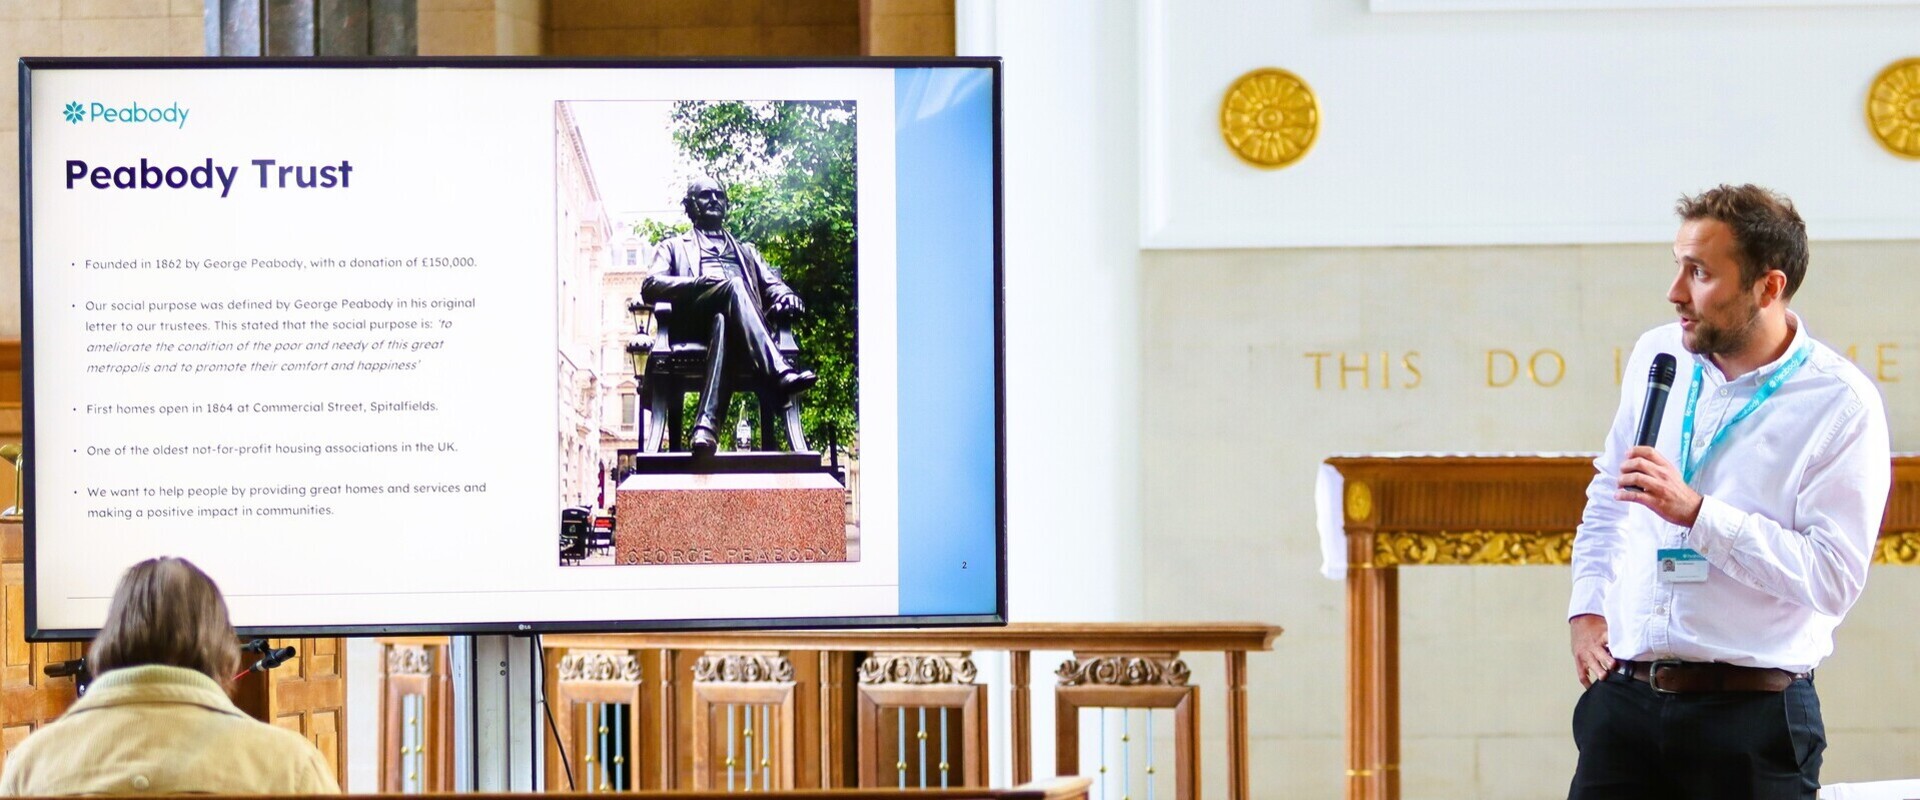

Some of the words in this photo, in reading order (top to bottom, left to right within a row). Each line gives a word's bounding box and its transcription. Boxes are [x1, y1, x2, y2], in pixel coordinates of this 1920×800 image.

[90, 101, 190, 129] Peabody
[66, 158, 239, 198] Peabody
[251, 159, 353, 188] Trust
[85, 258, 138, 270] Founded
[140, 258, 152, 269] in
[156, 258, 182, 270] 1862
[185, 258, 200, 272] by
[203, 258, 248, 272] George
[251, 258, 307, 271] Peabody,
[309, 257, 336, 268] with
[338, 259, 347, 268] a
[349, 257, 403, 268] donation
[405, 256, 418, 268] of
[421, 256, 478, 269] £150,000.
[85, 300, 107, 312] Our
[110, 300, 145, 311] social
[148, 301, 197, 313] purpose
[200, 301, 224, 311] was
[226, 299, 273, 310] defined
[275, 299, 291, 312] by
[293, 298, 338, 312] George
[341, 298, 394, 311] Peabody
[396, 297, 408, 309] in
[410, 297, 428, 309] his
[430, 297, 476, 312] original
[85, 321, 118, 332] letter
[120, 321, 134, 332] to
[136, 322, 157, 332] our
[159, 321, 211, 332] trustees.
[214, 319, 238, 331] This
[240, 319, 279, 331] stated
[282, 319, 307, 331] that
[309, 319, 330, 330] the
[332, 318, 367, 330] social
[369, 320, 418, 332] purpose
[420, 318, 433, 329] is:
[86, 341, 152, 353] ameliorate
[155, 341, 175, 352] the
[177, 341, 234, 352] condition
[236, 340, 251, 352] of
[252, 340, 272, 351] the
[273, 342, 303, 353] poor
[305, 340, 330, 351] and
[331, 340, 369, 352] needy
[370, 339, 386, 350] of
[387, 339, 409, 350] this
[410, 339, 445, 353] great
[86, 362, 151, 376] metropolis
[153, 362, 178, 373] and
[180, 362, 193, 373] to
[194, 362, 247, 375] promote
[250, 360, 278, 372] their
[280, 360, 329, 372] comfort
[330, 360, 355, 371] and
[1303, 350, 1423, 390] THIS
[1484, 348, 1567, 389] DO
[86, 403, 113, 415] First
[116, 403, 156, 415] homes
[158, 404, 189, 416] open
[192, 402, 203, 414] in
[207, 402, 234, 414] 1864
[236, 403, 250, 414] at
[252, 401, 324, 414] Commercial
[327, 401, 367, 413] Street,
[370, 400, 439, 414] Spitalfields.
[86, 445, 111, 457] One
[114, 444, 127, 456] of
[130, 445, 150, 456] the
[152, 444, 189, 456] oldest
[192, 443, 272, 457] not-for-profit
[275, 442, 322, 457] housing
[324, 441, 399, 454] associations
[401, 441, 412, 452] in
[415, 441, 435, 453] the
[437, 441, 458, 453] UK.
[86, 487, 107, 498] We
[109, 487, 140, 498] want
[143, 487, 156, 497] to
[159, 485, 185, 499] help
[187, 485, 228, 499] people
[231, 485, 247, 498] by
[249, 484, 307, 498] providing
[309, 484, 342, 498] great
[345, 483, 385, 495] homes
[386, 483, 410, 494] and
[413, 482, 461, 494] services
[463, 482, 487, 493] and
[87, 506, 133, 521] making
[135, 509, 144, 518] a
[147, 506, 194, 520] positive
[197, 505, 239, 519] impact
[242, 505, 253, 516] in
[255, 504, 334, 516] communities.
[627, 548, 713, 564] GEORGE
[727, 547, 834, 562] PEABODY
[962, 561, 967, 570] 2
